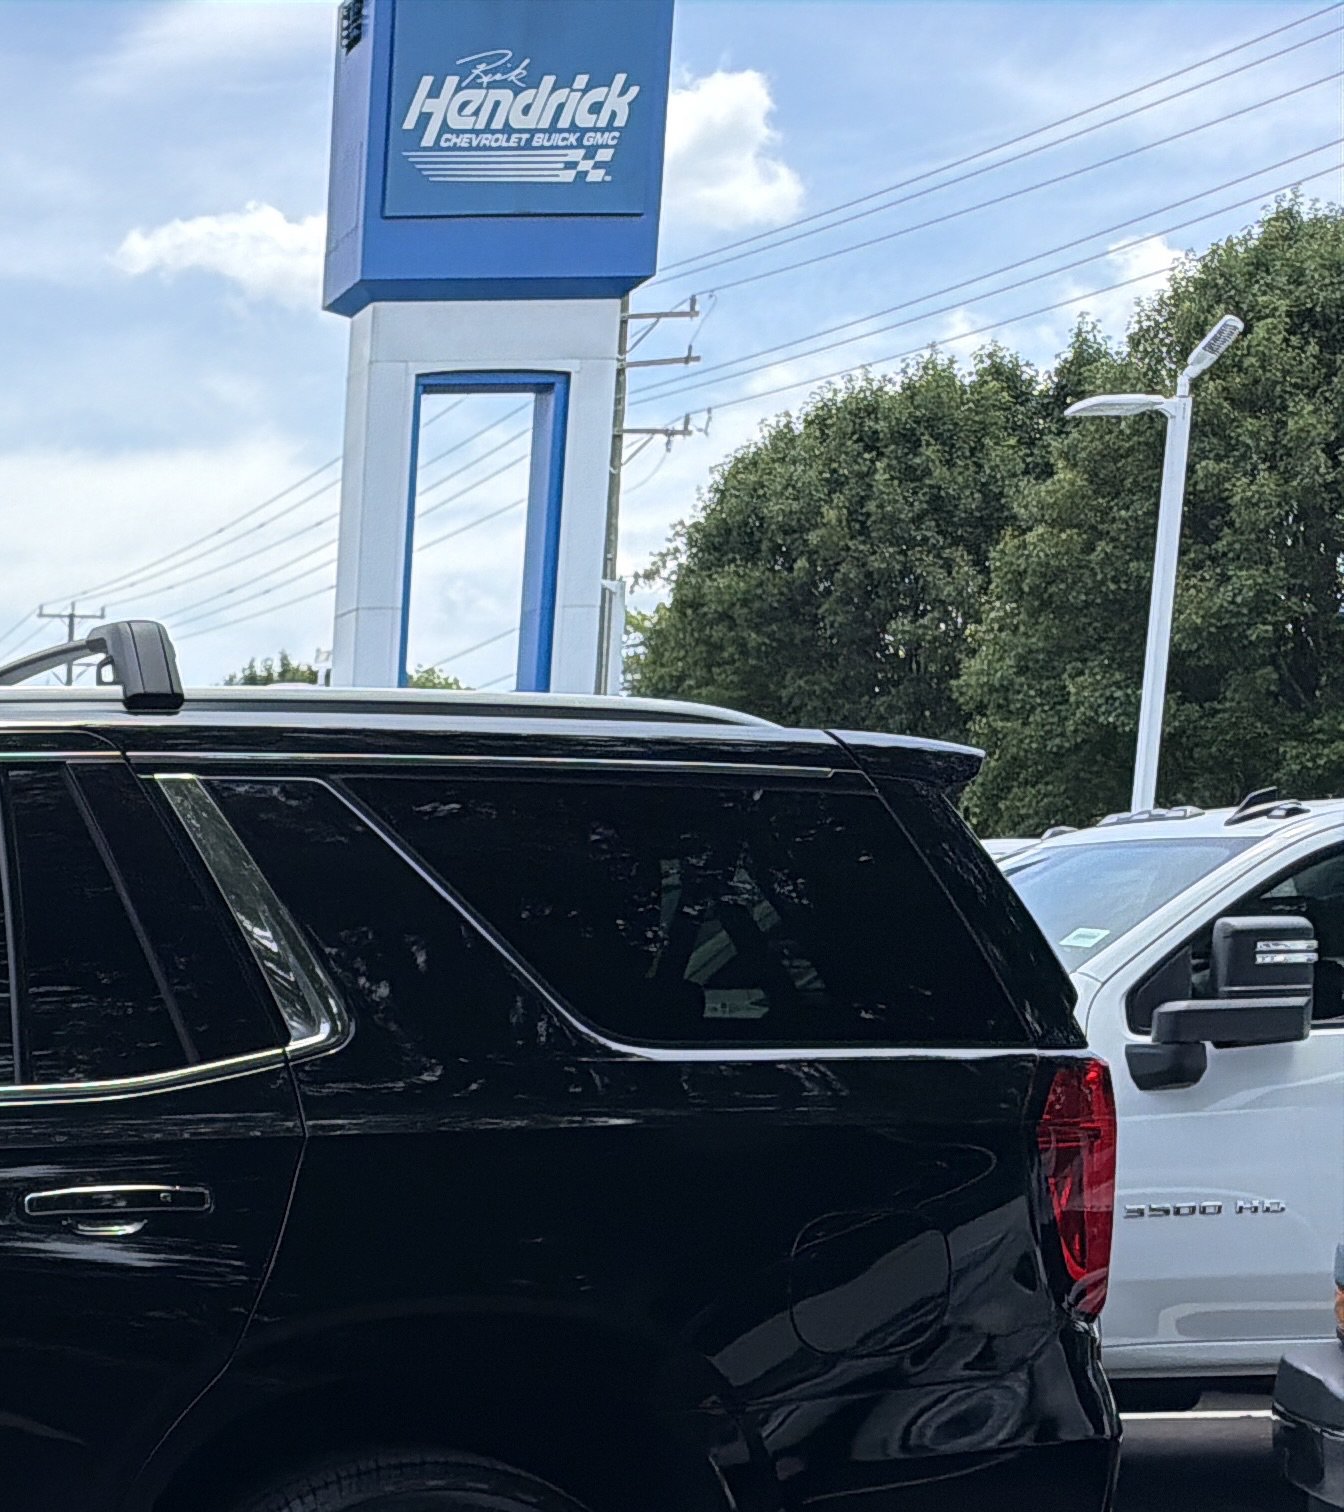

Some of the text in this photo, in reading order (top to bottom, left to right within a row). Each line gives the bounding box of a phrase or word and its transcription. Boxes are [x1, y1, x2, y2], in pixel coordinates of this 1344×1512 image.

[402, 73, 640, 147] Hendrick
[440, 131, 620, 147] CHEVROLET BUICK GMC
[1235, 1200, 1286, 1214] HD
